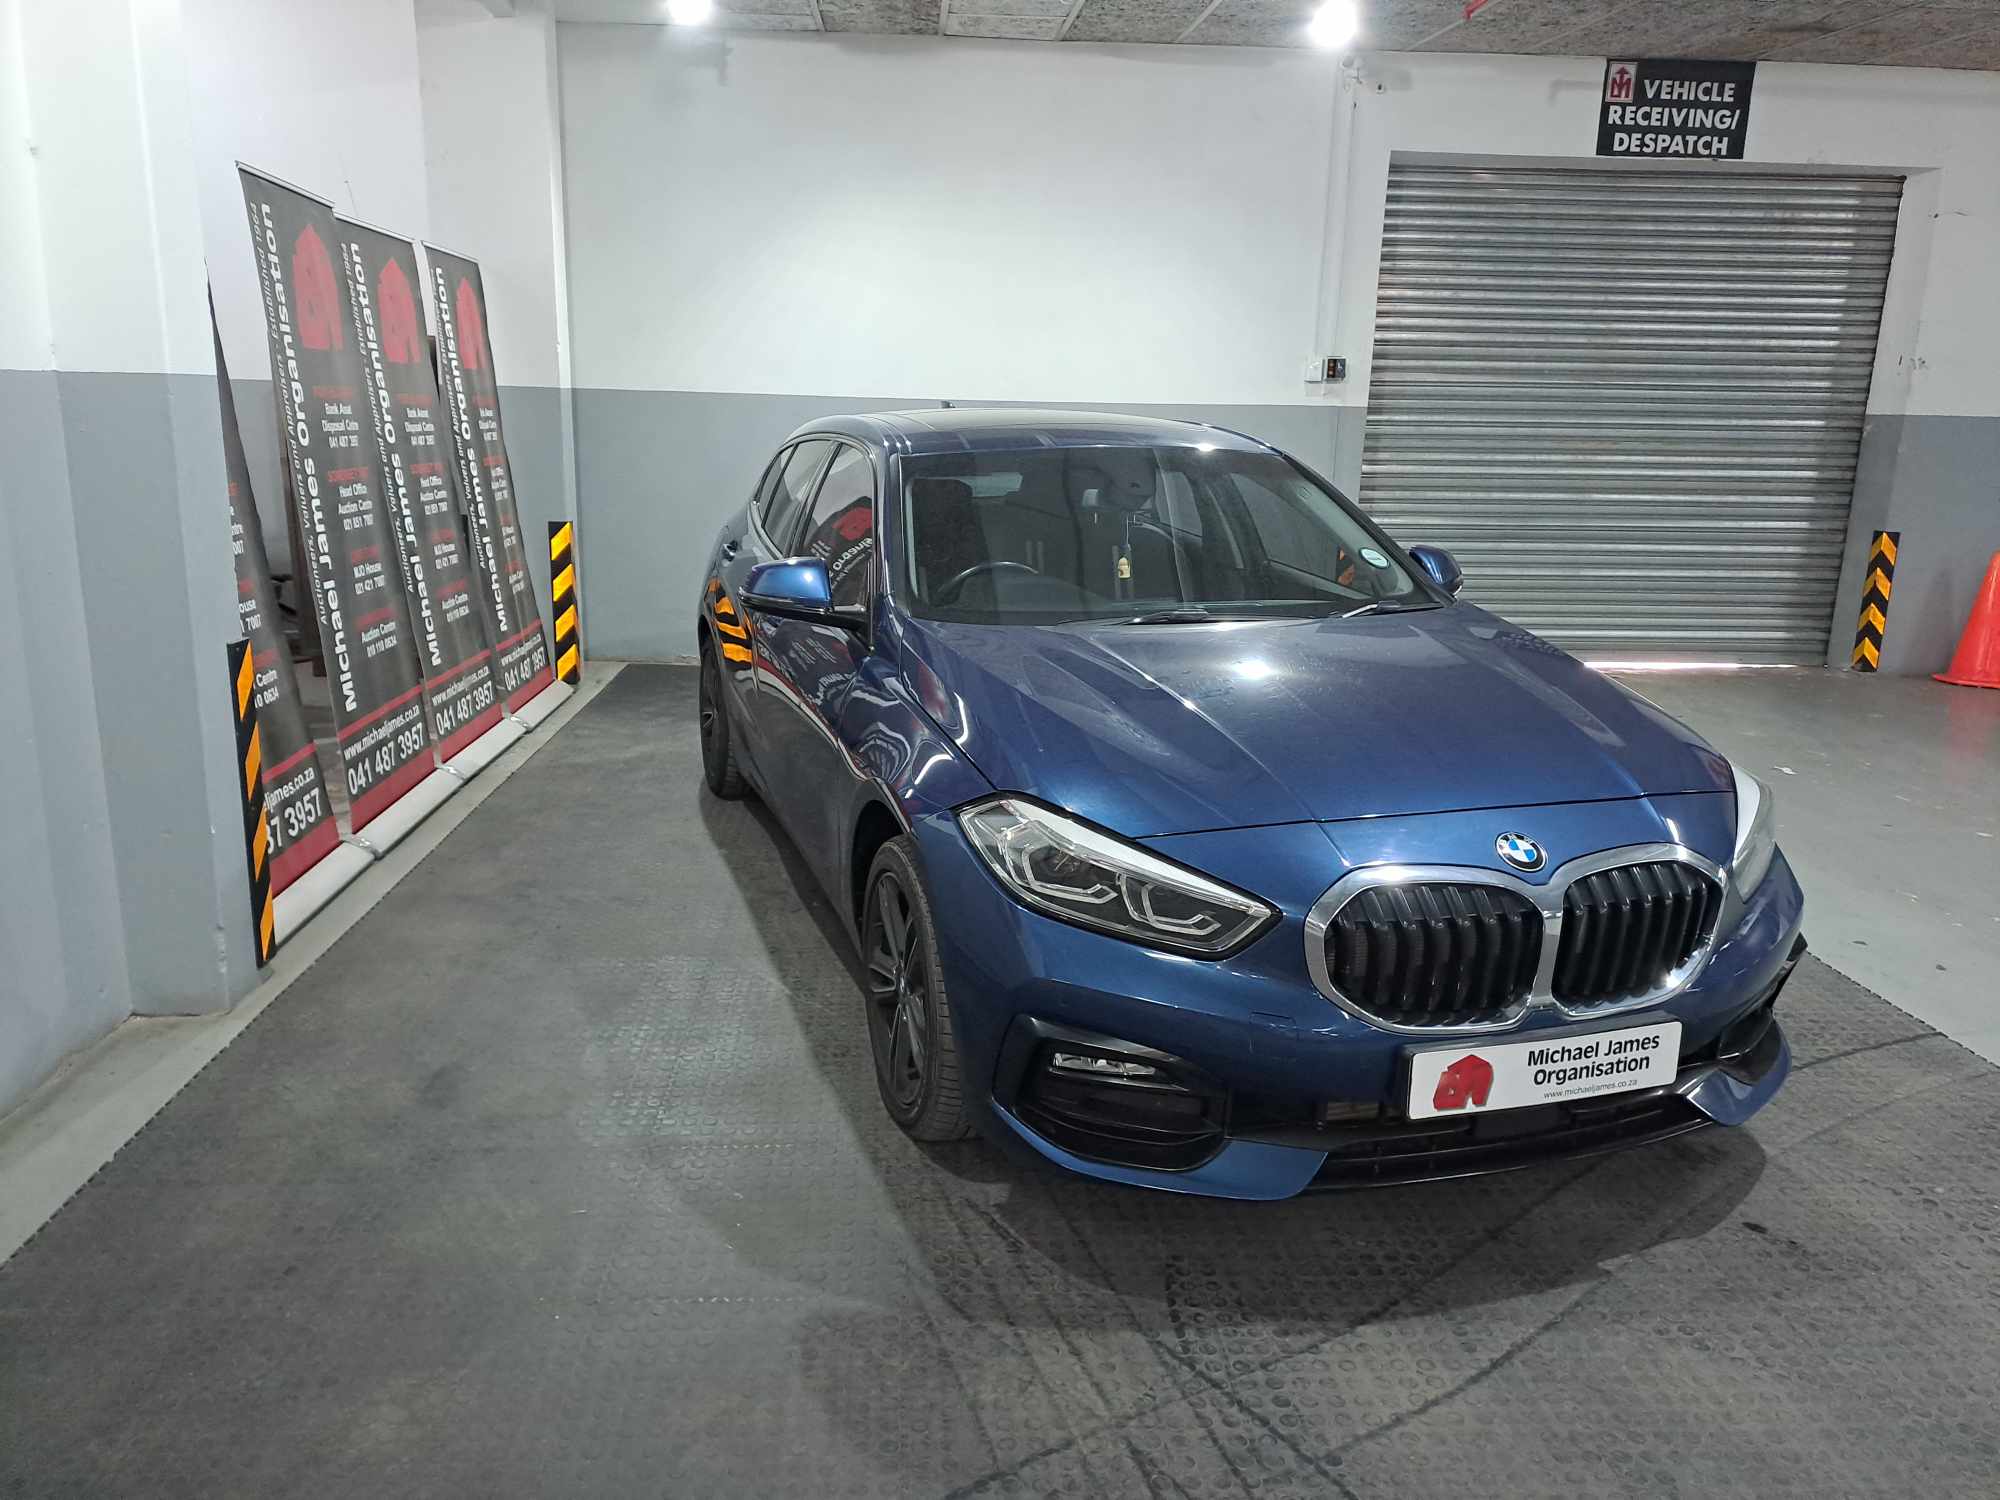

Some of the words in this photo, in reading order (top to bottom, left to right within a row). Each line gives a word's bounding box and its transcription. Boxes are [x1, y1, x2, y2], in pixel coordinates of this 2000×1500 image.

[1607, 105, 1740, 130] RECEIVING/
[1643, 79, 1735, 102] VEHICLE
[1613, 132, 1728, 155] DESPATCH
[261, 203, 309, 446] Organisation
[350, 242, 396, 444] Organisation
[435, 267, 471, 440] Organisation
[289, 439, 301, 469] and
[377, 437, 388, 463] and
[296, 473, 311, 529] Valuers
[304, 457, 333, 570] James
[391, 453, 418, 548] James
[467, 448, 488, 529] James
[410, 555, 442, 666] Michael
[482, 536, 508, 632] Michael
[323, 579, 357, 712] Michael
[504, 666, 520, 692] 041
[435, 705, 456, 736] 041
[456, 694, 473, 721] 487
[473, 680, 493, 711] 3957
[348, 757, 372, 795] 041
[375, 741, 395, 776] 487
[397, 721, 424, 760] 3957
[284, 787, 322, 837] 3957
[1527, 1041, 1600, 1067] Michael
[1604, 1035, 1660, 1057] James
[1533, 1056, 1650, 1085] Organisation
